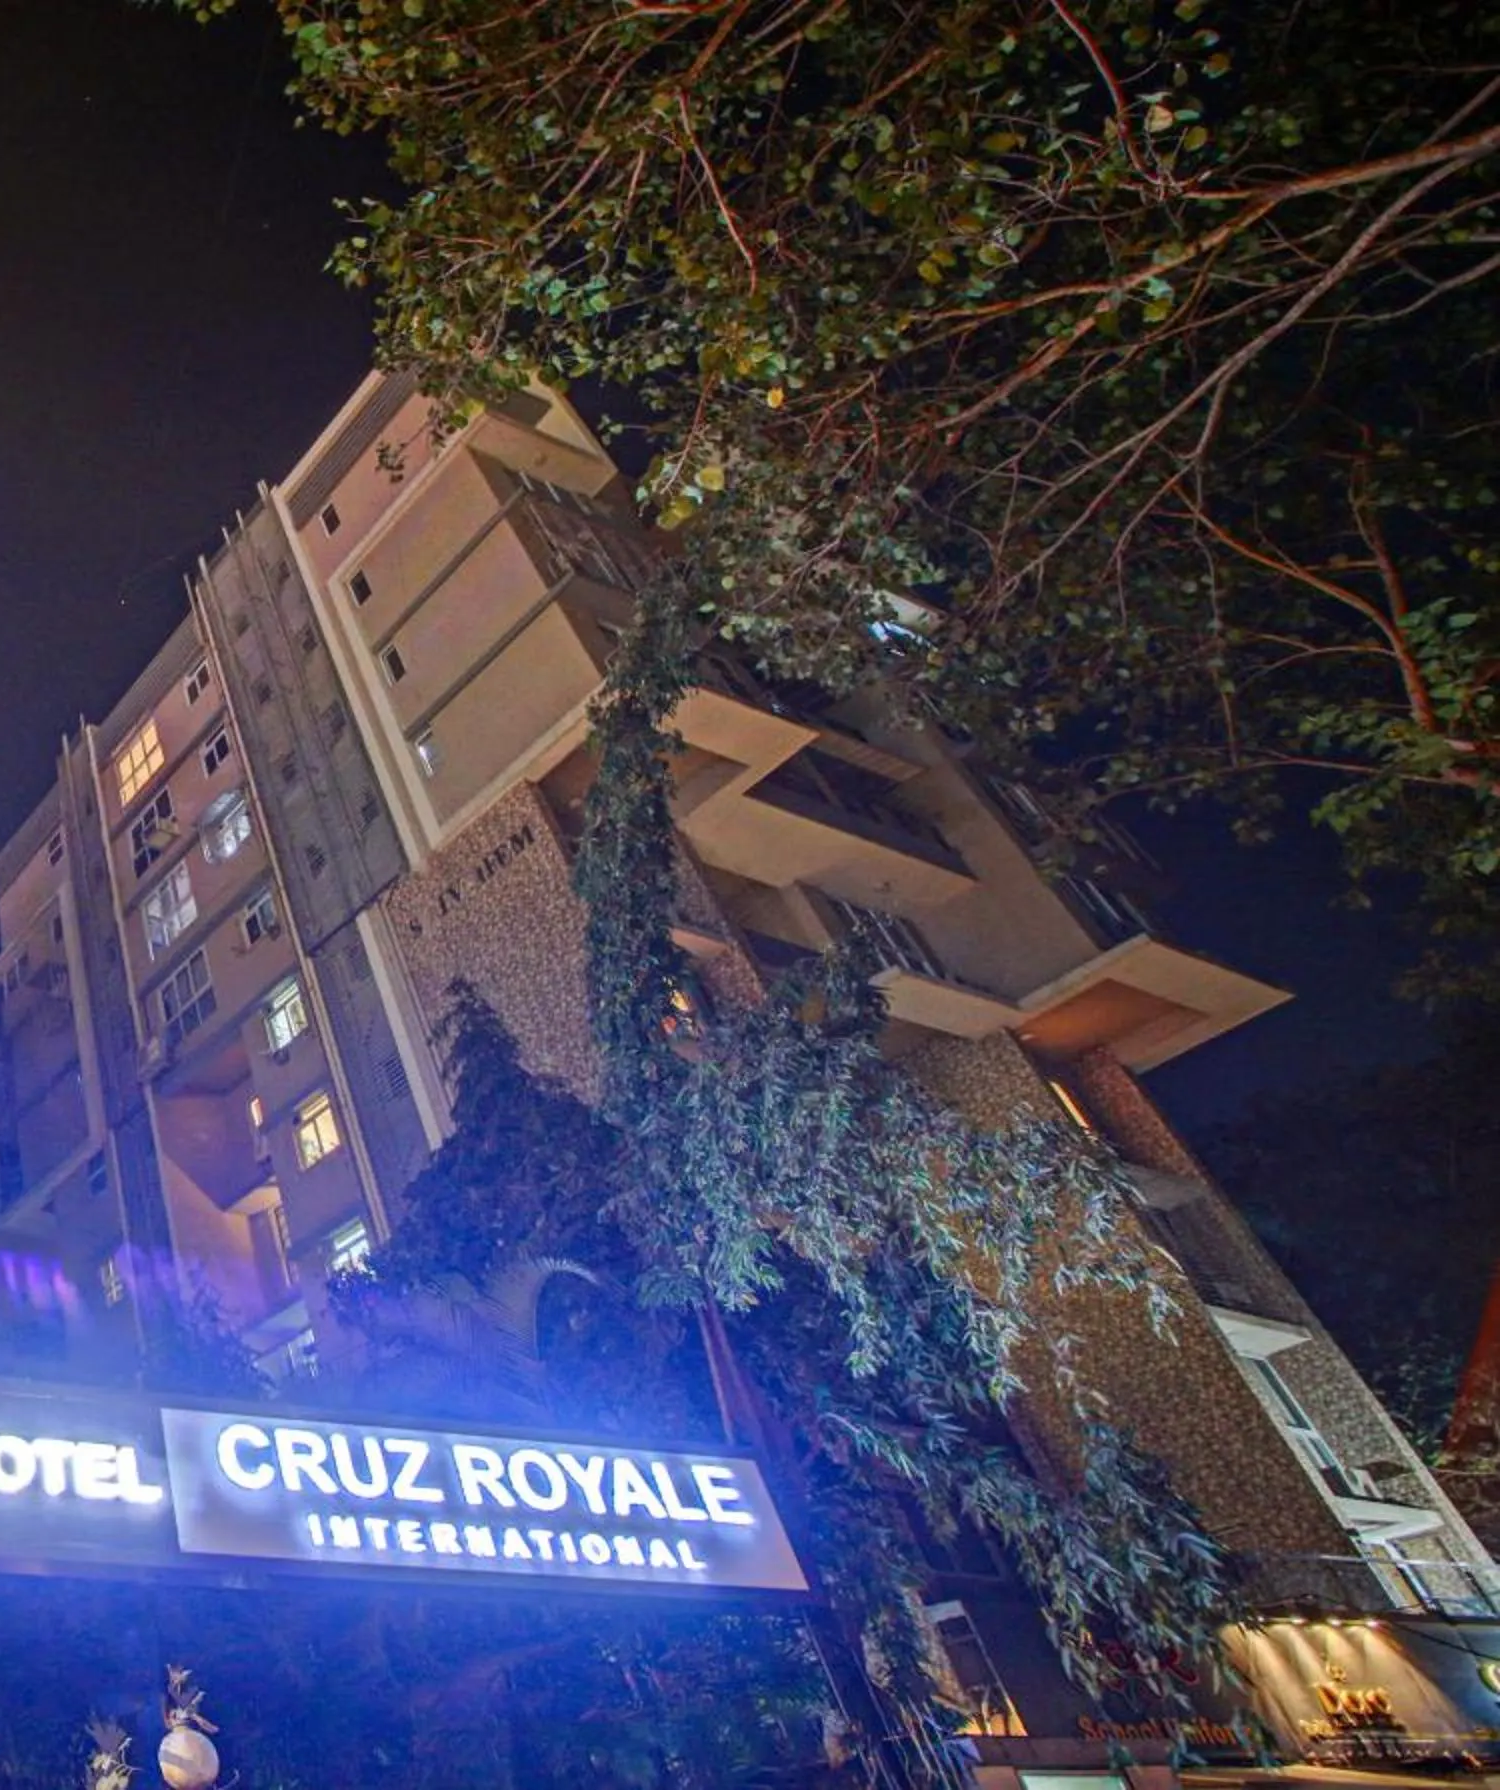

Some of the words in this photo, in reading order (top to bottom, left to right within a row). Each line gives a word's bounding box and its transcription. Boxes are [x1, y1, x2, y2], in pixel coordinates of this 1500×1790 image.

[217, 1423, 446, 1503] CRUZ
[452, 1444, 755, 1525] ROYALE
[307, 1513, 707, 1570] INTERNATIONAL
